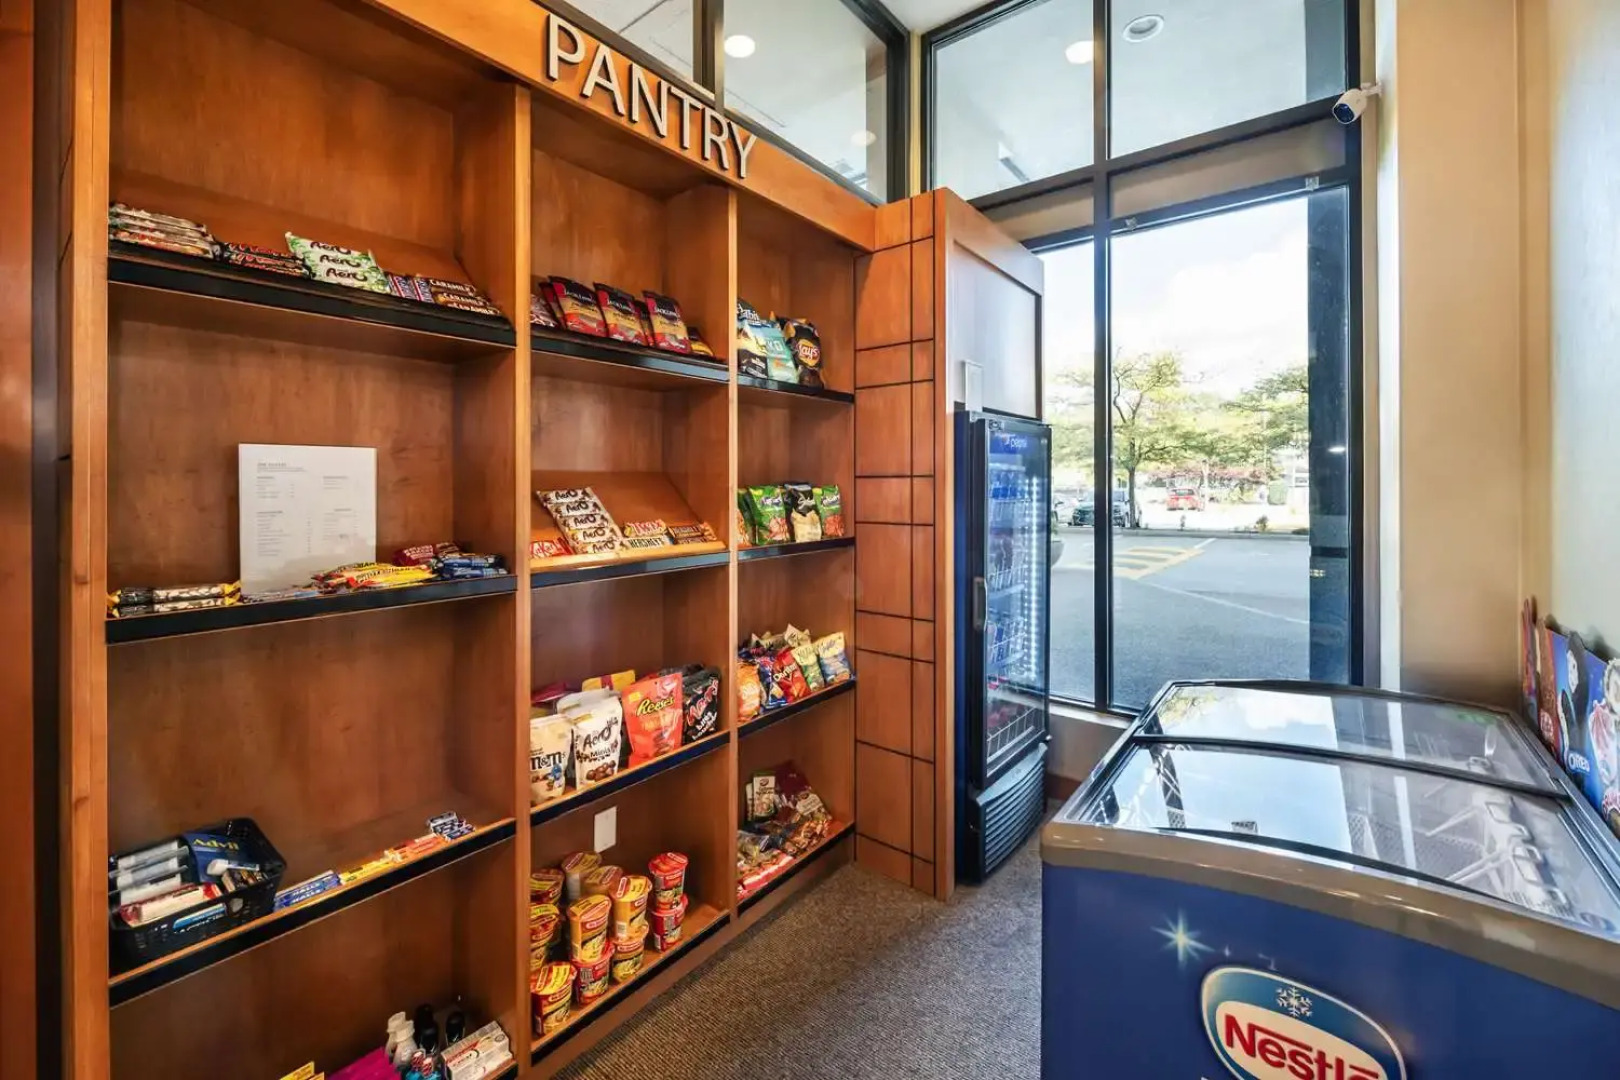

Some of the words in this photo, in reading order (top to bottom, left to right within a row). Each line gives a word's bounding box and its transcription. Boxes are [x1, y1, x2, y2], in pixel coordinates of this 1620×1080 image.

[547, 13, 758, 179] PANTRY
[326, 267, 368, 282] Aero
[554, 489, 578, 500] Aero
[566, 500, 589, 513] Aero
[573, 514, 597, 526] Aero
[582, 527, 606, 540] Aero
[592, 540, 615, 553] Aero
[582, 726, 612, 752] Aero
[1225, 1013, 1380, 1080] Nestl
